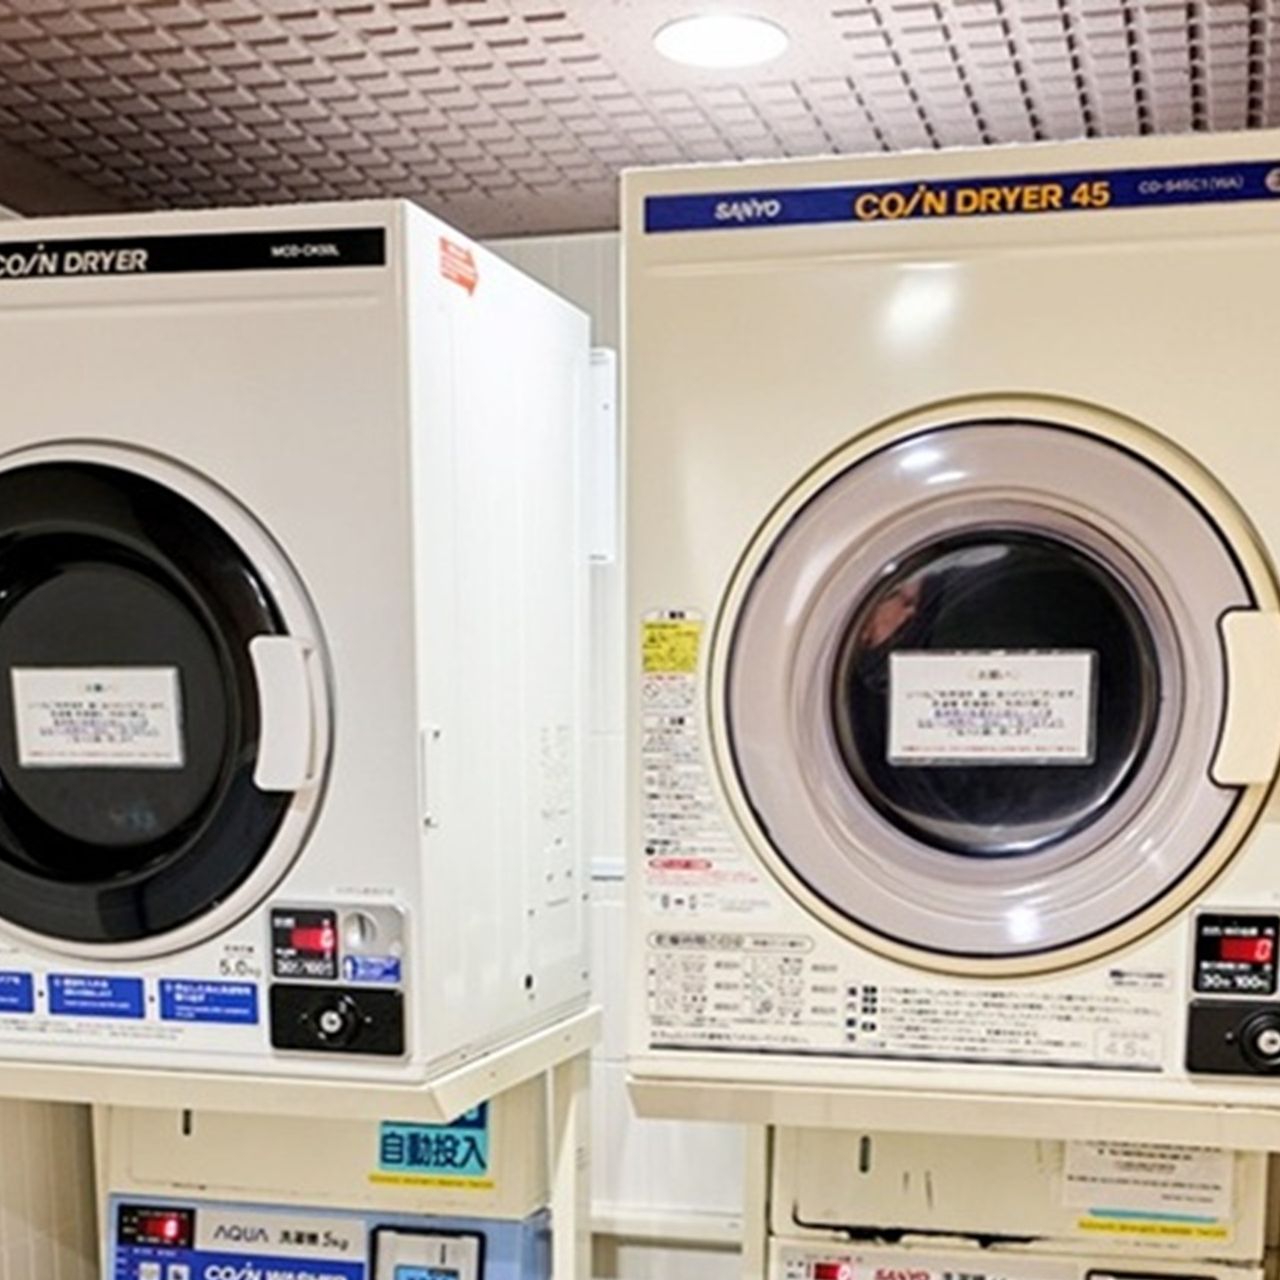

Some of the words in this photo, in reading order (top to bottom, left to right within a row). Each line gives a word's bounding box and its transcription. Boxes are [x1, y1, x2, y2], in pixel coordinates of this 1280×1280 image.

[956, 184, 1062, 213] DRYER
[1072, 181, 1111, 207] 45
[714, 198, 781, 221] SANYO
[63, 249, 148, 273] DRYER
[381, 1131, 487, 1170] 自動投入
[214, 1225, 269, 1243] AQUA
